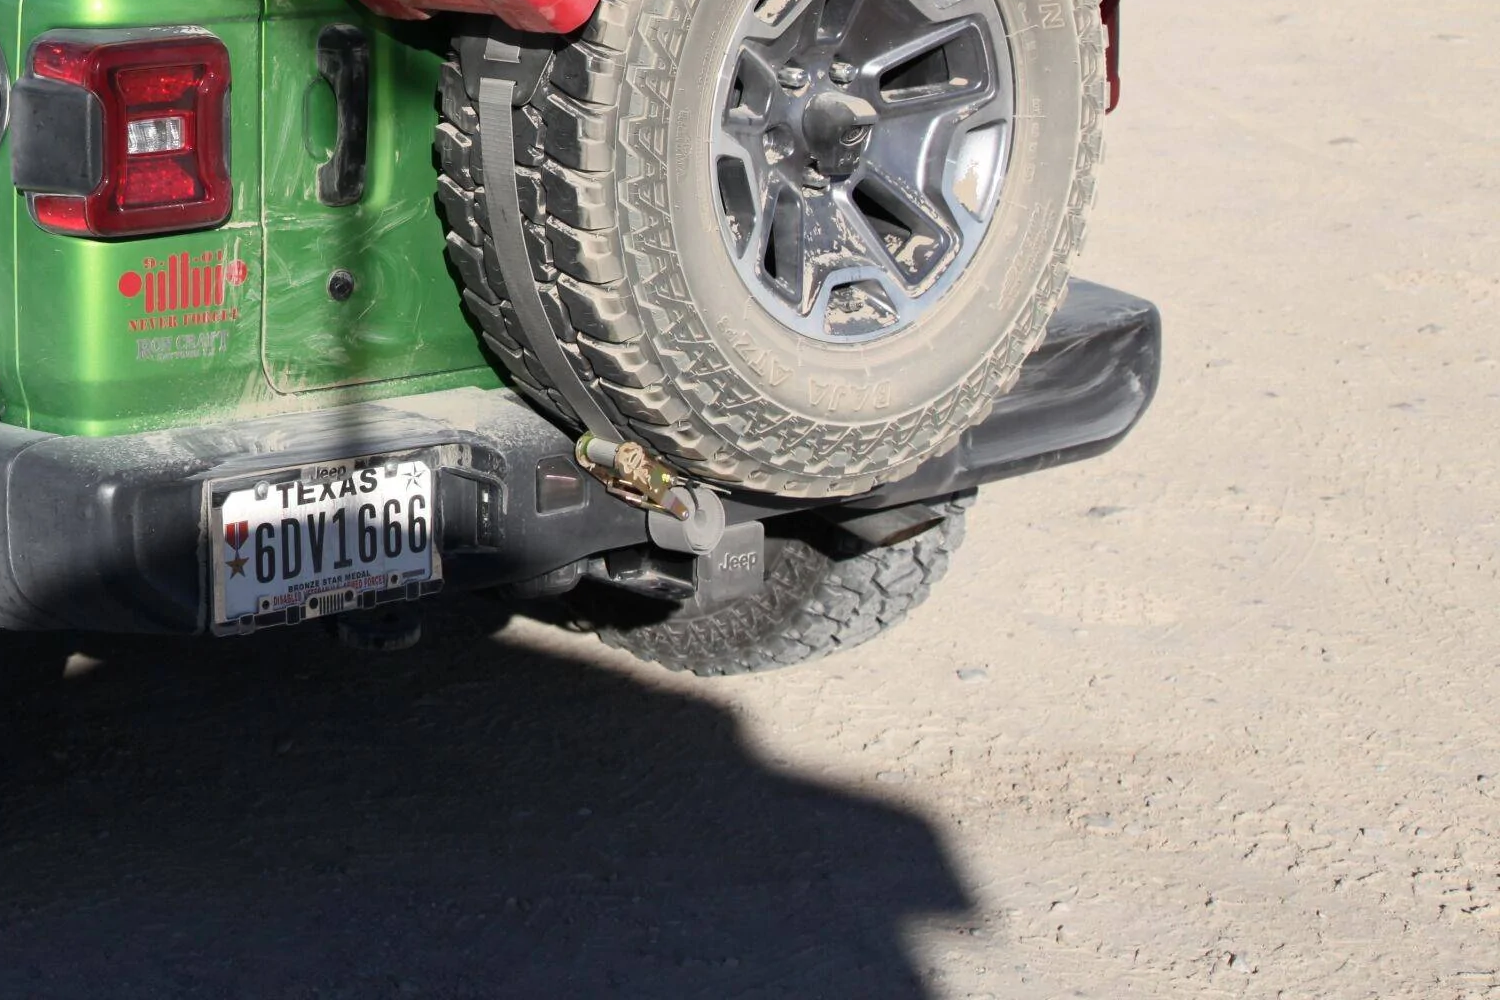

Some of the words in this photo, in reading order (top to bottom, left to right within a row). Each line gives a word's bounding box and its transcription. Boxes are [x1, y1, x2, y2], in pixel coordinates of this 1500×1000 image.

[129, 315, 179, 332] NEVER
[808, 374, 892, 412] BAJA
[312, 464, 347, 480] Jeep
[276, 468, 379, 509] TEXAS
[255, 494, 427, 584] 6DV1666
[718, 551, 757, 571] Jeep
[288, 580, 320, 593] BRONZE
[322, 576, 343, 586] STAR
[344, 570, 371, 582] MEDAL
